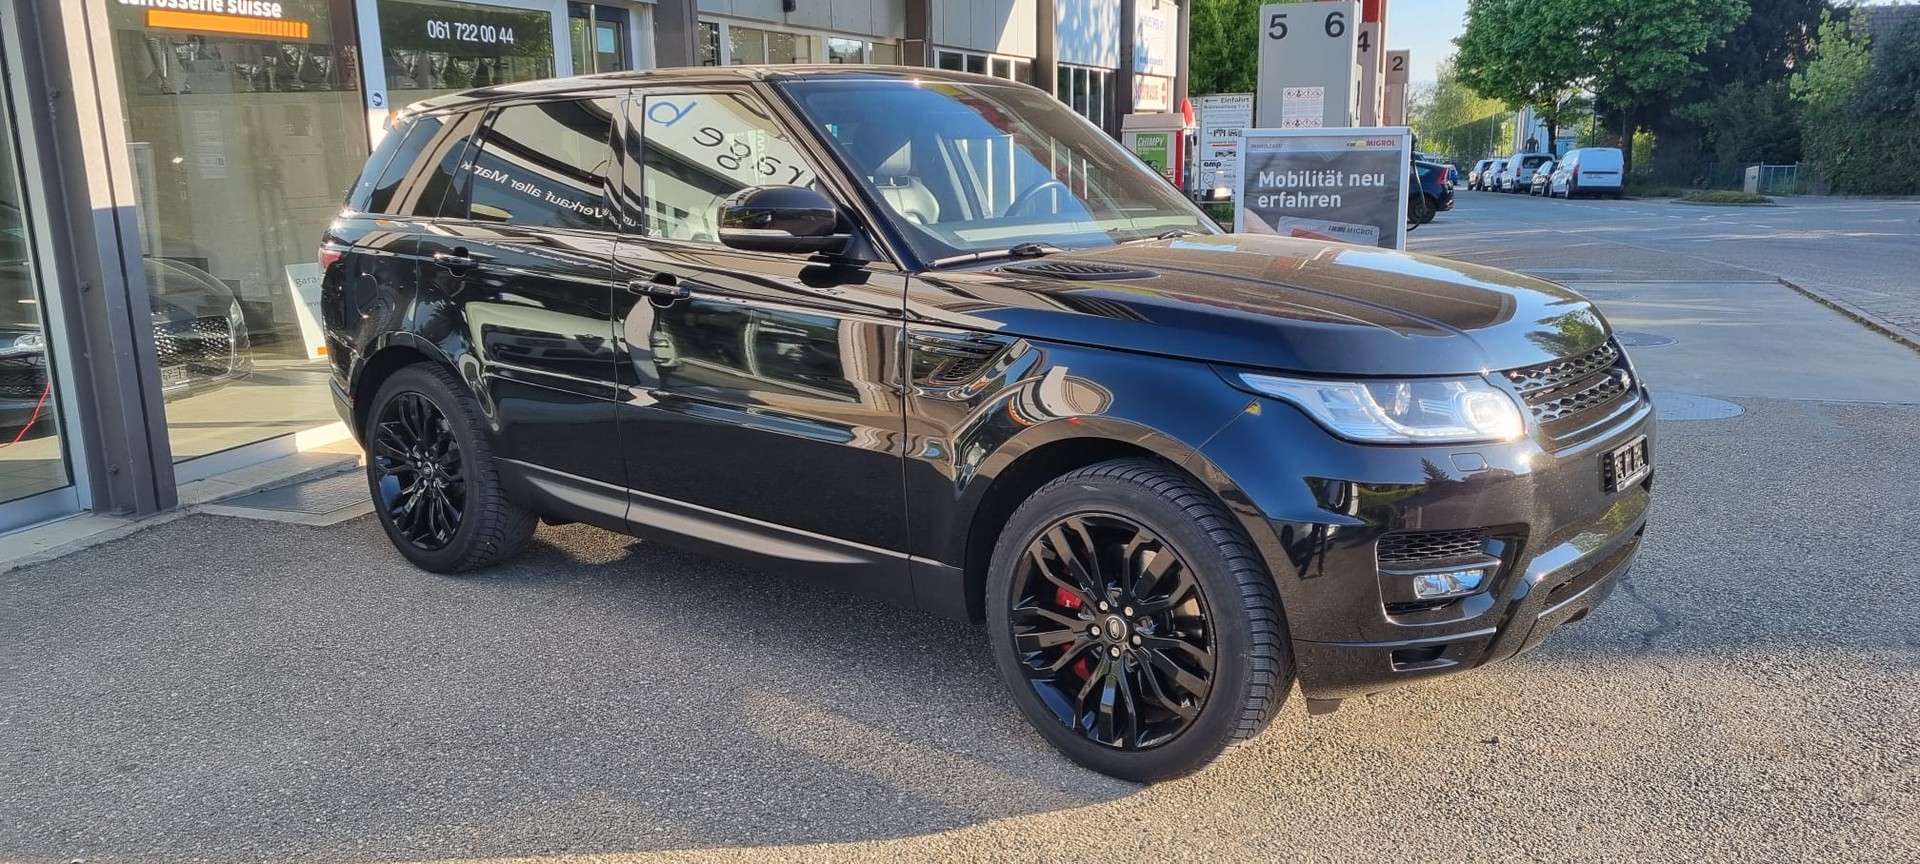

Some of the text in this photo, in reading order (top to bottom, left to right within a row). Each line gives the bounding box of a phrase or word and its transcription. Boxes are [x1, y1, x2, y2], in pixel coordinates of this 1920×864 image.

[118, 0, 282, 18] osserie suisse
[427, 19, 514, 45] 061 722 00 44
[1268, 13, 1288, 40] 5
[1325, 11, 1345, 38] 6
[1357, 30, 1370, 52] 4
[1392, 55, 1404, 71] 2
[1137, 136, 1165, 147] CHIMPY
[1366, 139, 1395, 147] MIGROL
[1203, 161, 1222, 169] amp
[1258, 170, 1385, 188] Mobilität neu
[1257, 191, 1342, 208] erfahren
[1346, 226, 1374, 236] MIGROL
[295, 277, 320, 287] gara
